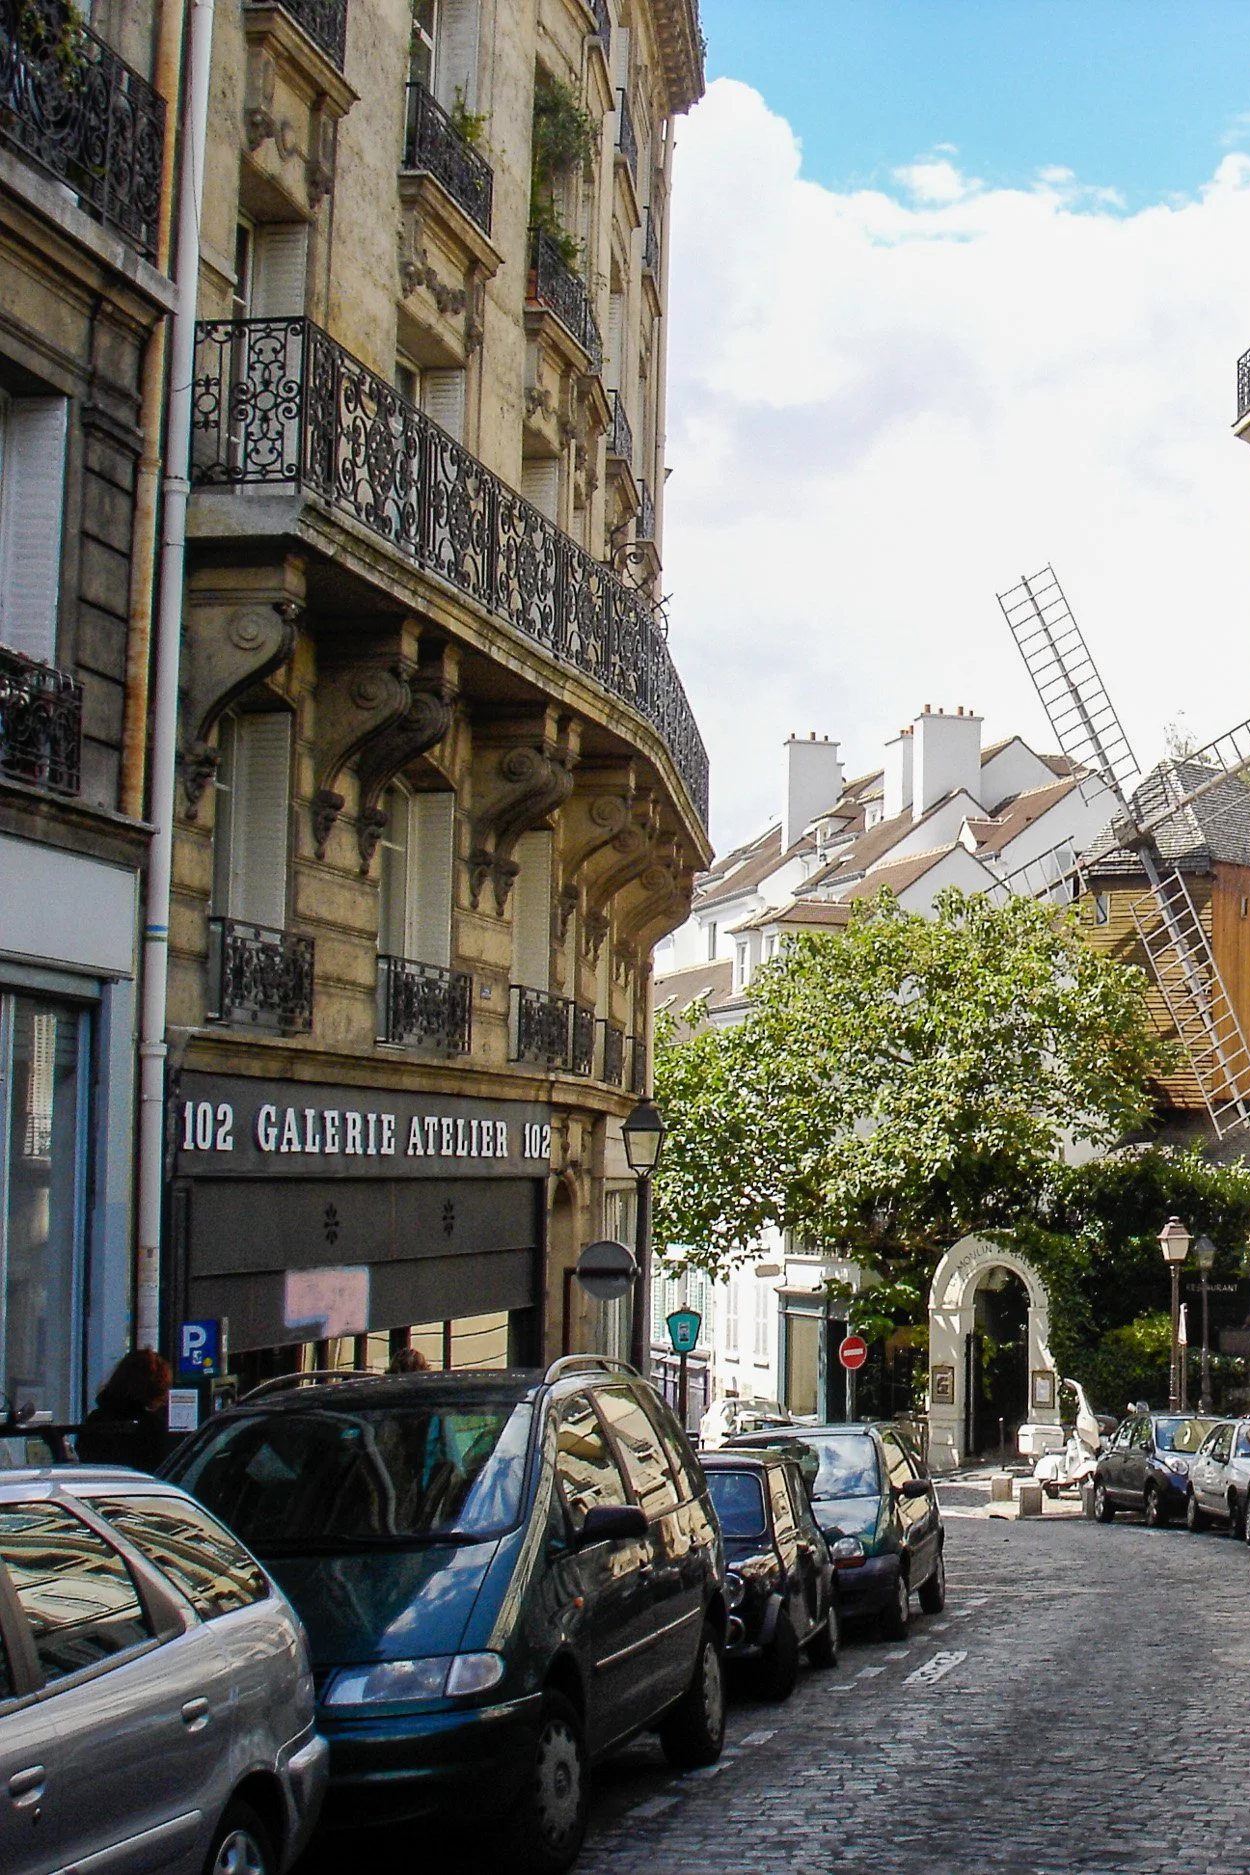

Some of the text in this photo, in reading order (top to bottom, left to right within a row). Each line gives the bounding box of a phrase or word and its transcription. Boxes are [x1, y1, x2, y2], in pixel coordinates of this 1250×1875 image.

[182, 1100, 551, 1160] 102 GALERIE ATELIER 102
[955, 1243, 994, 1271] MOULIN
[183, 1325, 207, 1358] P
